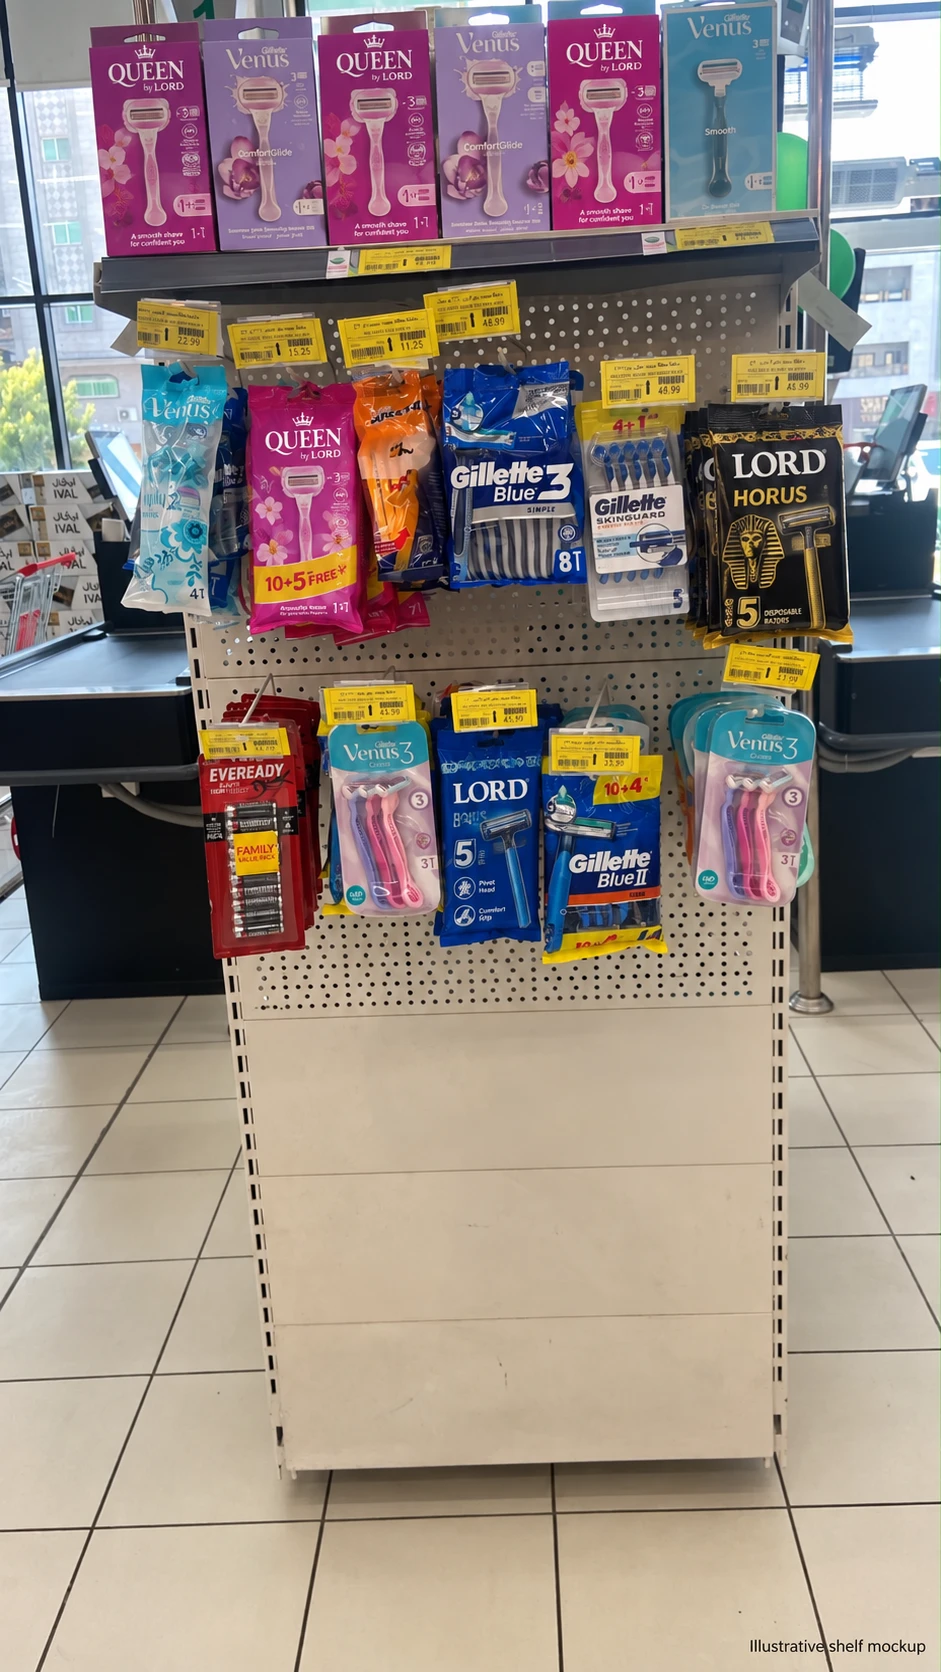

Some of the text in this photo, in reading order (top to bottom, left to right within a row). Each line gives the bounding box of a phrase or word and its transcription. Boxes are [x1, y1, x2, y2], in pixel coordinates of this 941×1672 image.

[687, 16, 752, 39] Venus
[456, 32, 520, 54] Venus
[566, 40, 643, 67] QUEEN
[226, 48, 290, 70] Venus
[336, 50, 412, 77] QUEEN
[611, 62, 642, 71] LORD
[108, 60, 184, 88] QUEEN
[382, 72, 413, 81] LORD
[143, 82, 184, 93] by LORD
[705, 127, 736, 136] Smooth
[238, 148, 293, 158] ComfortGlide
[464, 141, 523, 152] ComfortGlide
[288, 347, 311, 357] 15.25
[401, 341, 424, 350] 11.25
[152, 396, 211, 420] Venus
[613, 414, 647, 432] 4+1
[265, 428, 342, 455] QUEEN
[311, 449, 341, 459] LORD
[732, 449, 826, 479] LORD
[450, 461, 543, 489] Gillette
[493, 463, 574, 502] Blue 3
[53, 489, 79, 499] IVAL
[594, 494, 666, 516] Gillette
[733, 486, 808, 507] HORUS
[55, 524, 81, 534] IVAL
[596, 511, 666, 525] SKINGUARD
[558, 551, 582, 573] 8T
[265, 569, 338, 591] 10+5 FREE
[84, 593, 102, 604] IVA
[737, 597, 759, 627] 5
[343, 741, 414, 764] Venus 3
[727, 730, 799, 760] Venus 3
[209, 763, 284, 782] EVEREADY
[453, 778, 528, 804] LORD
[236, 843, 275, 856] FAMILY
[456, 840, 474, 866] 5
[568, 848, 652, 874] Gillette
[597, 868, 649, 889] Blue II
